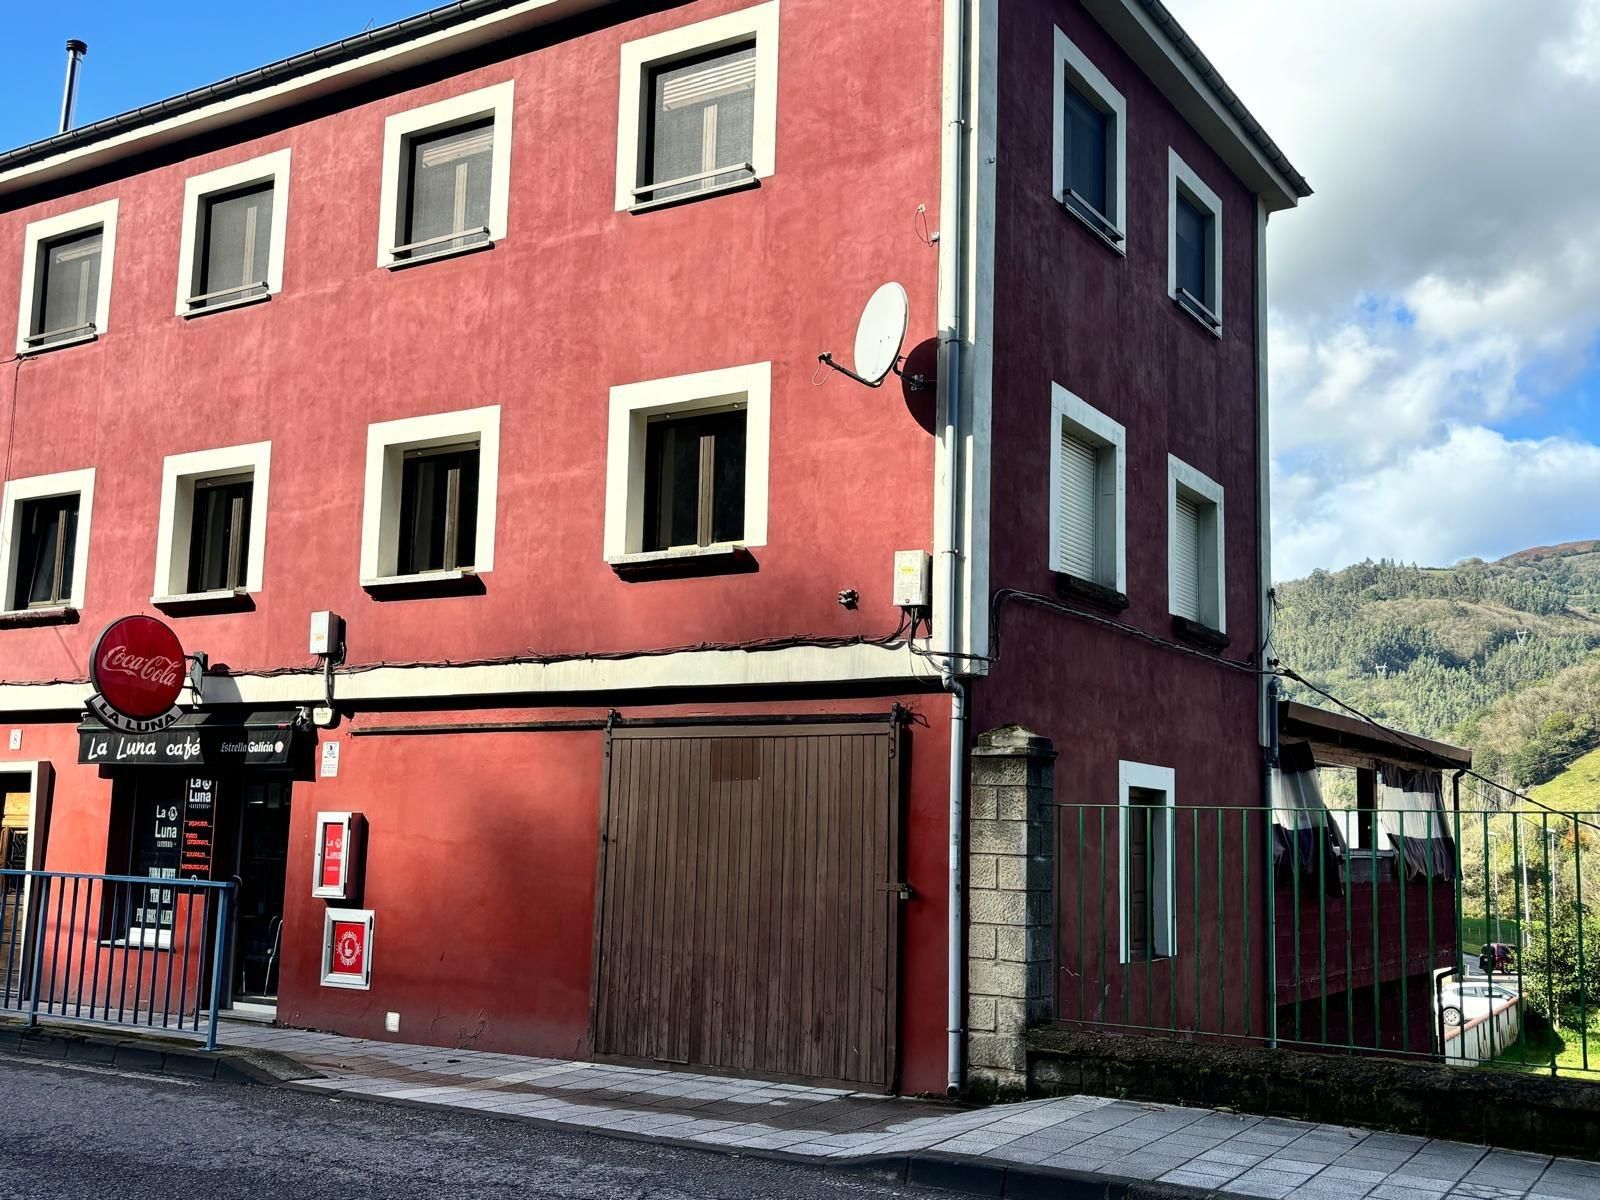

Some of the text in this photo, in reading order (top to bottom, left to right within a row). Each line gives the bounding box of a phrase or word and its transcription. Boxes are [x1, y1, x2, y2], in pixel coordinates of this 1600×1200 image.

[101, 645, 181, 687] Coca-Cola
[98, 702, 177, 732] LA LUNA
[87, 736, 200, 760] La Luna café
[220, 741, 274, 753] Estrella Galicia
[190, 778, 201, 788] La
[189, 789, 211, 803] Luna
[156, 805, 166, 818] La
[155, 820, 177, 838] Luna
